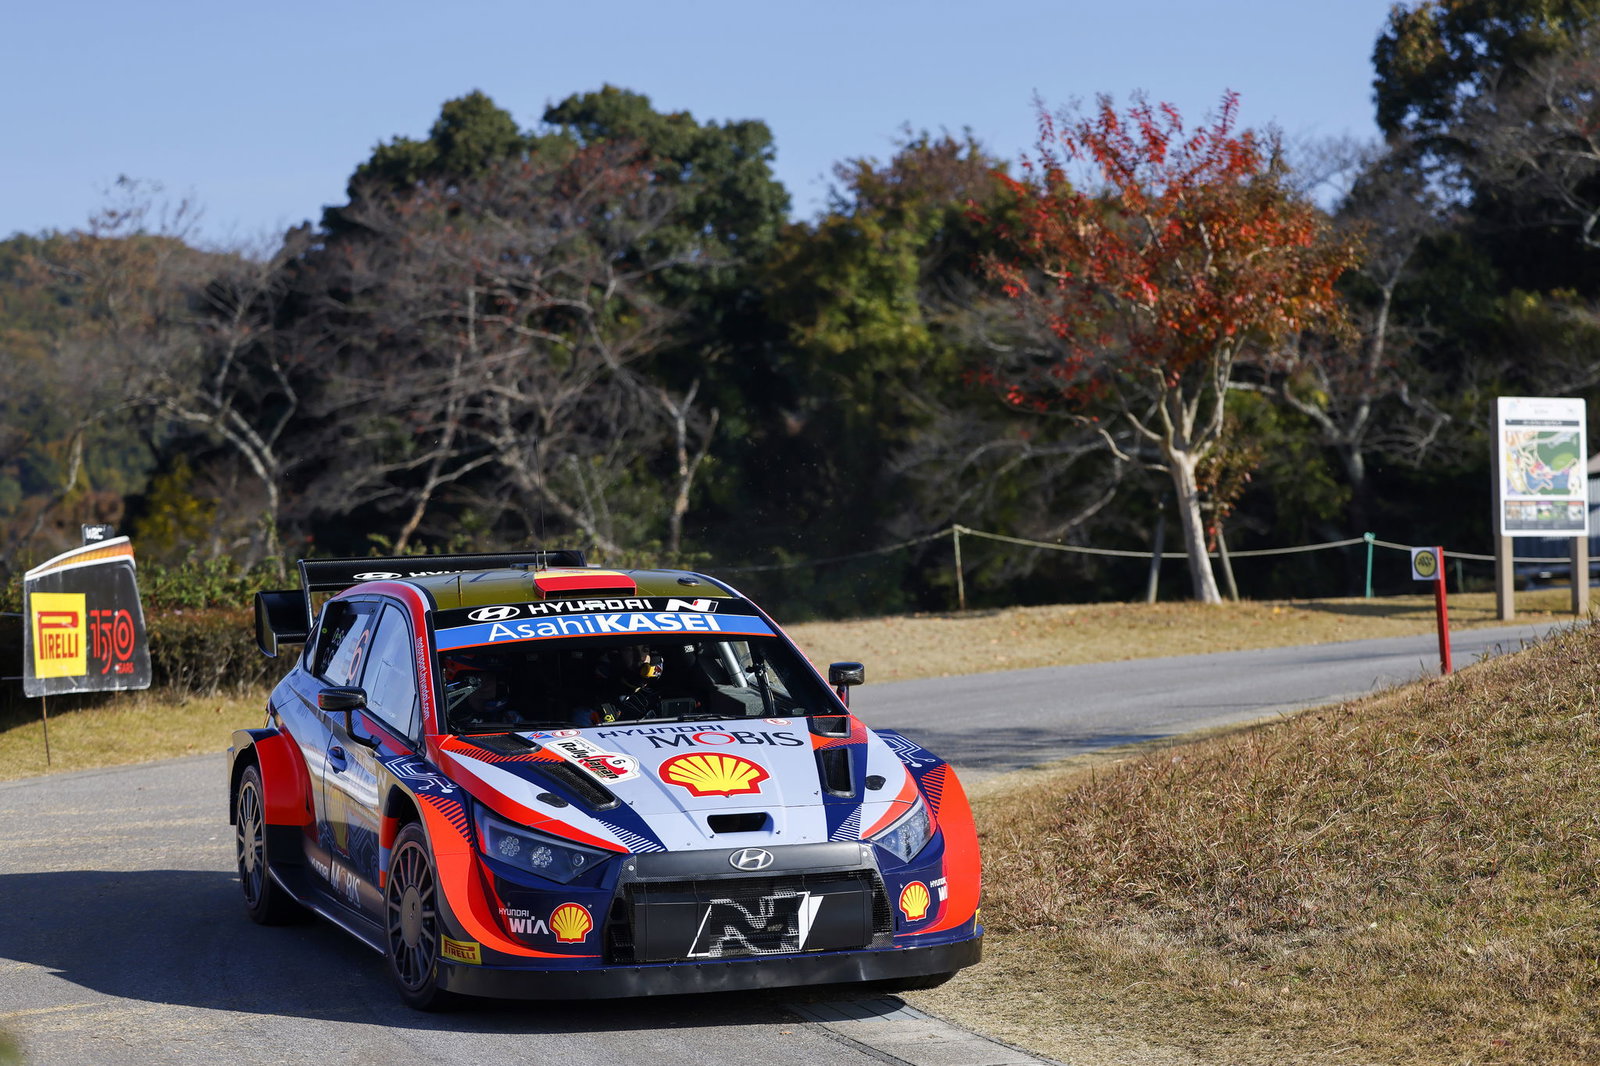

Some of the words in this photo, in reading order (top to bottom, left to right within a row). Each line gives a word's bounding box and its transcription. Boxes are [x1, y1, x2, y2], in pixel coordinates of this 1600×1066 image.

[86, 526, 104, 540] WRC
[527, 599, 653, 615] HYUNDAI
[38, 611, 79, 660] PIRELLI
[487, 613, 722, 642] AsahiKASEI
[90, 608, 135, 675] 150
[348, 629, 370, 681] 6
[597, 724, 727, 739] HYUNDAI
[645, 730, 805, 750] MOBIS
[557, 741, 591, 759] Rally
[584, 758, 619, 780] Japan
[498, 907, 530, 918] HYUNDAI
[508, 915, 550, 935] WIA
[444, 939, 477, 960] PIRELLI
